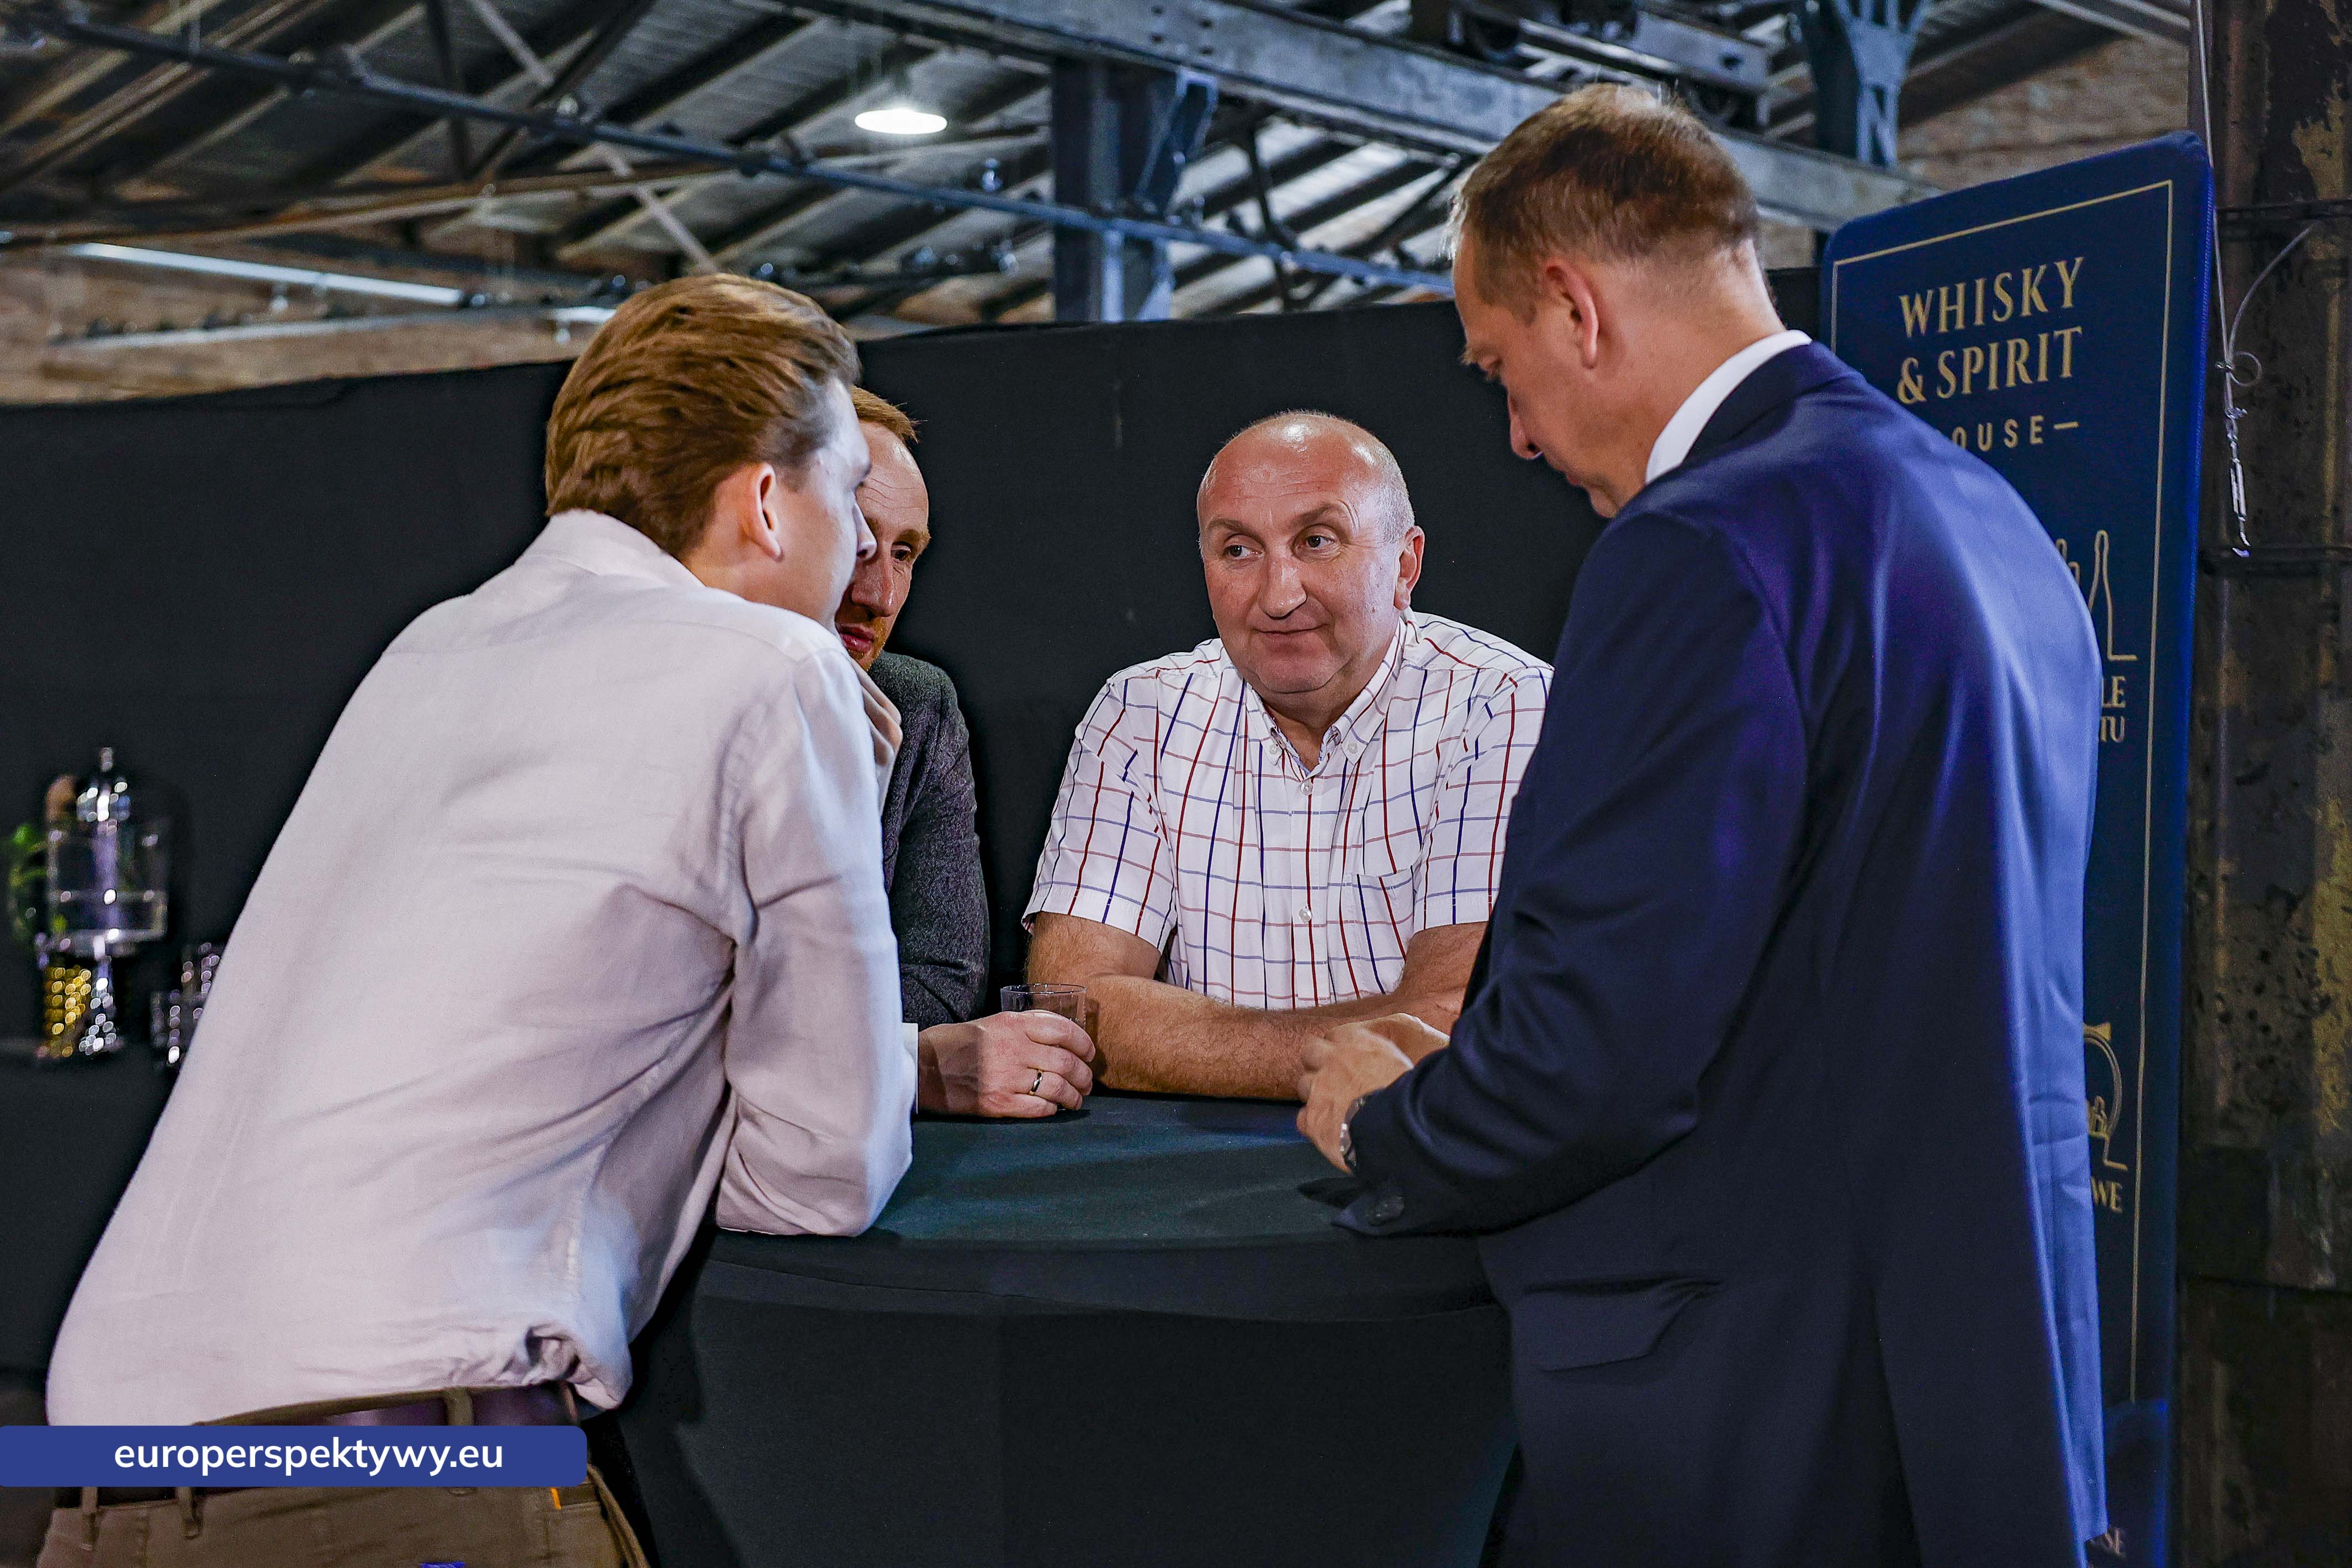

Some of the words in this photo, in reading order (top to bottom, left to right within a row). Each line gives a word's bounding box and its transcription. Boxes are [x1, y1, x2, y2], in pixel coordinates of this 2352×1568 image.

[1898, 256, 2085, 338] WHISKY
[1896, 357, 1927, 405] &
[1936, 326, 2083, 399] SPIRIT
[1951, 415, 2044, 452] OUSE
